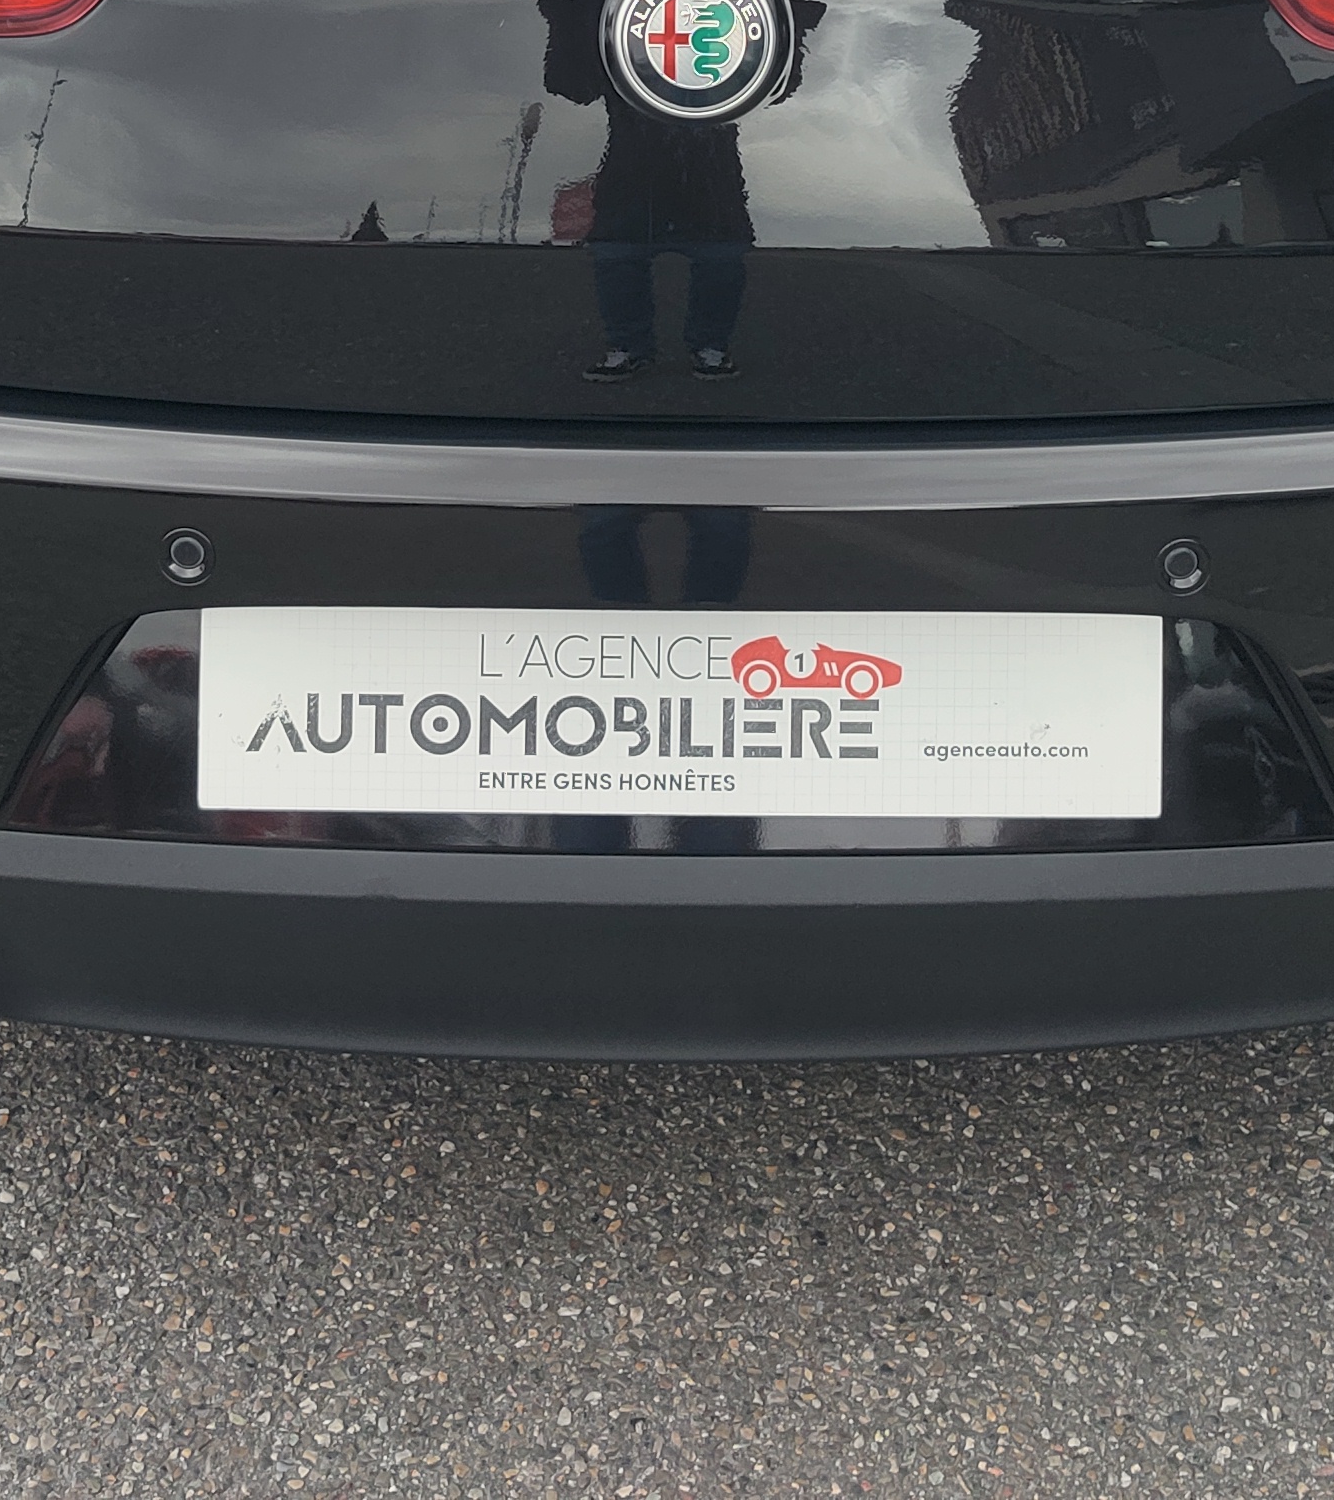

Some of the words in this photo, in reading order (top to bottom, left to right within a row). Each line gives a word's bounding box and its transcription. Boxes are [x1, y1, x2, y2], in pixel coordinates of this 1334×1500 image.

[480, 633, 733, 680] L'AGENCE
[923, 740, 1089, 761] agenceauto.com
[479, 771, 547, 790] ENTRE
[553, 772, 612, 791] GENS
[619, 769, 736, 792] HONNÊTES
